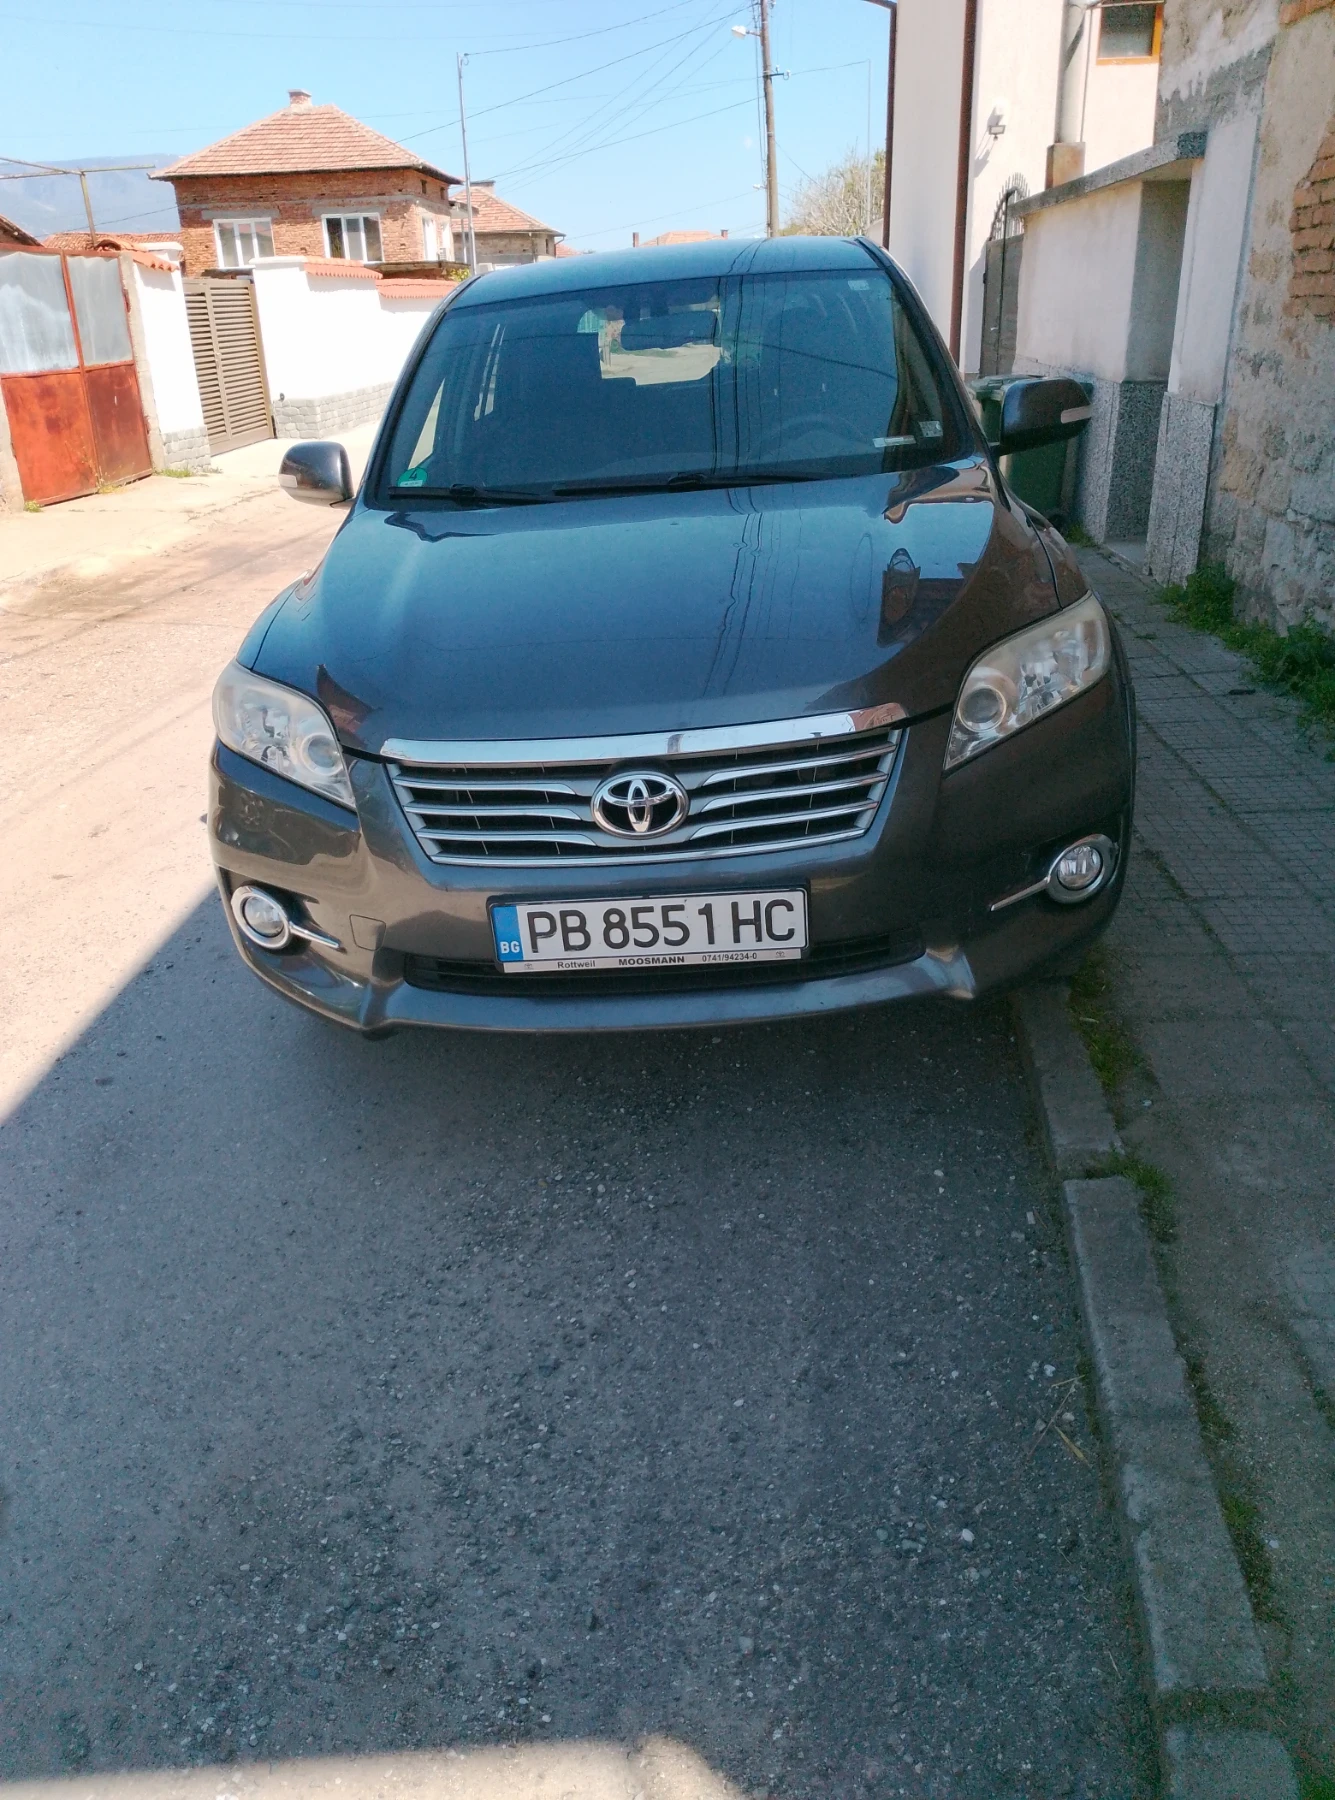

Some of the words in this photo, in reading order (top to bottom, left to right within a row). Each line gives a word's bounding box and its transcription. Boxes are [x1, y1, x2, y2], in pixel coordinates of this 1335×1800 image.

[408, 468, 418, 481] 4
[526, 910, 591, 954] PB
[602, 902, 716, 948] 8551
[730, 898, 796, 944] HC
[500, 940, 521, 954] BG
[556, 959, 596, 969] Rottweil
[618, 955, 685, 966] MOOSMANN
[701, 952, 758, 962] 0741/94234-0
